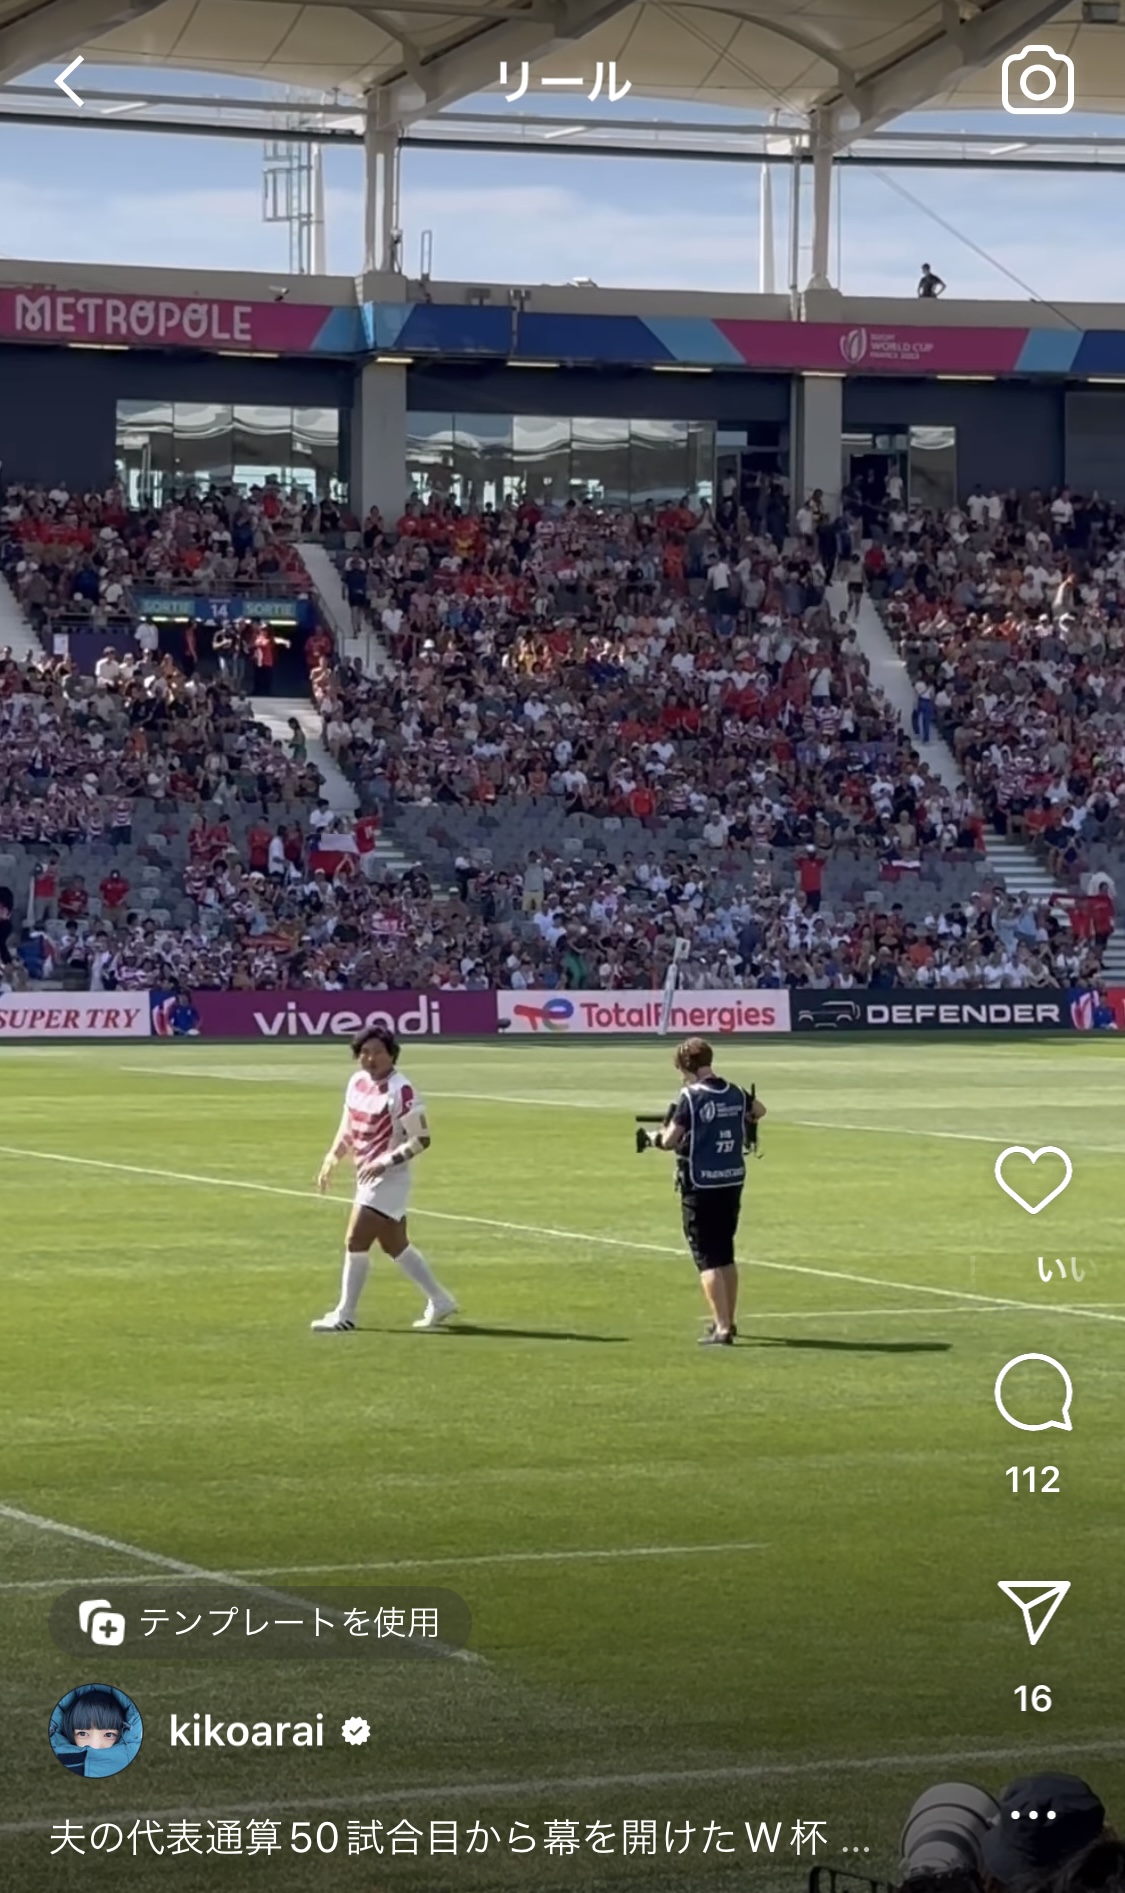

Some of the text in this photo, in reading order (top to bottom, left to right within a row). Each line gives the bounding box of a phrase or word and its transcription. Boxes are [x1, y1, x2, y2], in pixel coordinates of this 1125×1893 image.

[210, 603, 229, 618] 14
[246, 601, 293, 616] SORTIE
[0, 1007, 141, 1030] SUPER TRY
[866, 1004, 1060, 1024] DEFENDER
